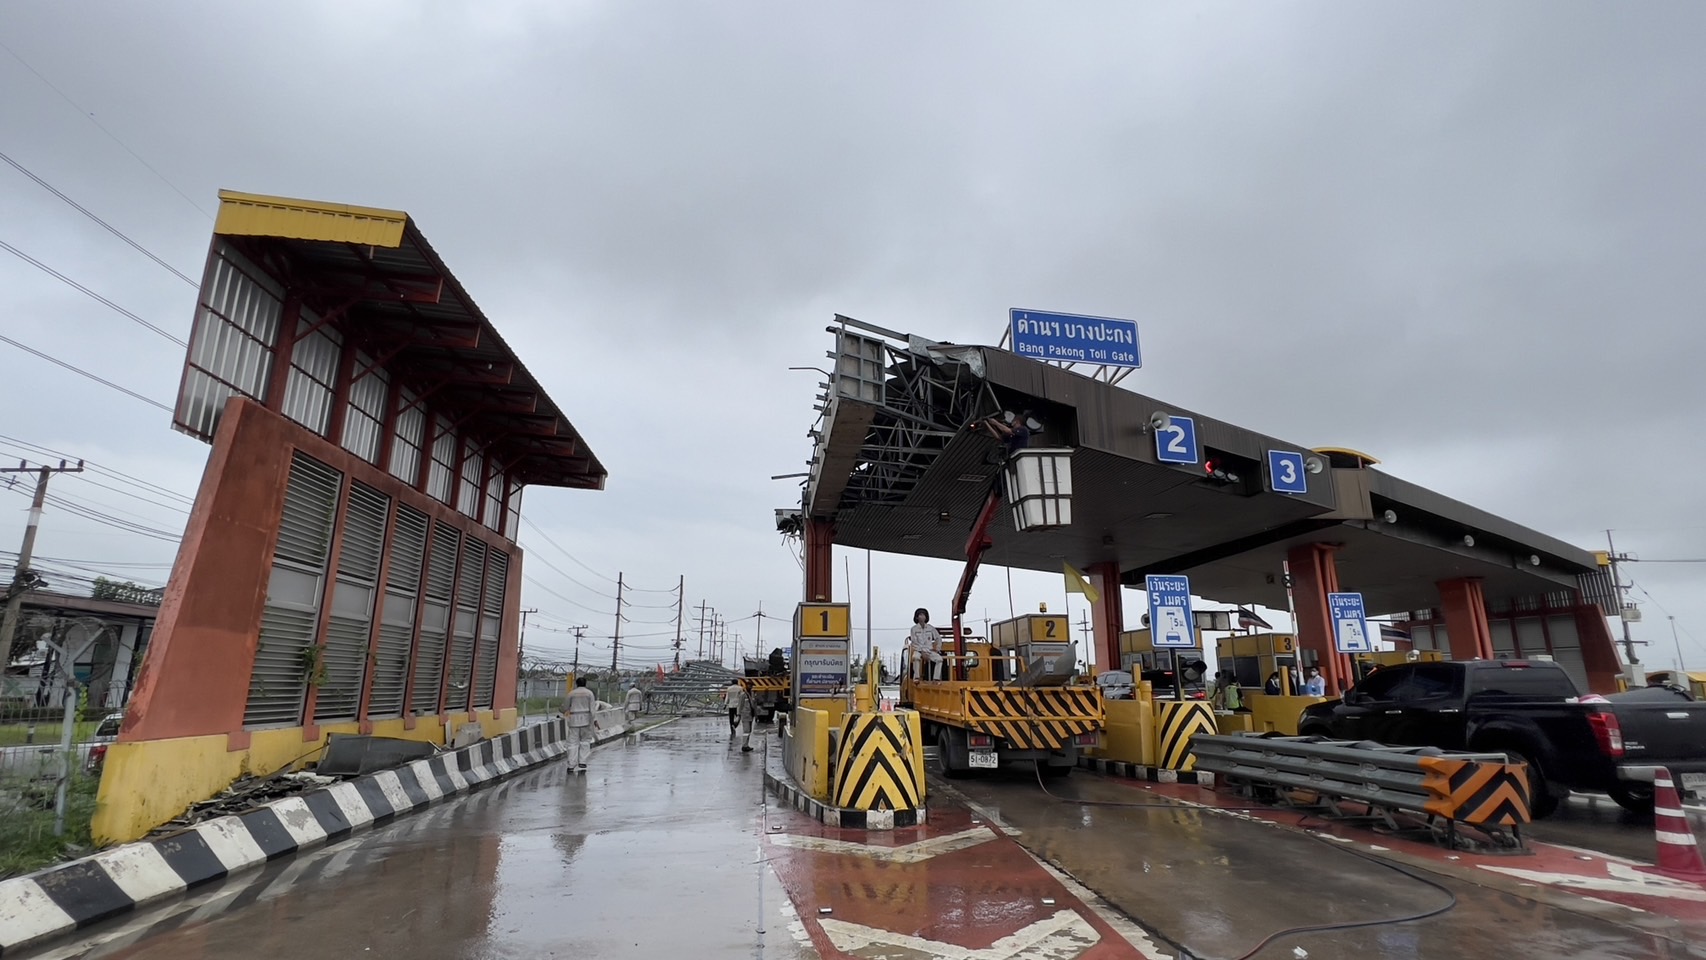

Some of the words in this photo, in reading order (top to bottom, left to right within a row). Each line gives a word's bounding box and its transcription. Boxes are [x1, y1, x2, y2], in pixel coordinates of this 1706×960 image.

[1017, 313, 1060, 338] ด่านฯ
[1064, 322, 1133, 345] บางปะกง
[1019, 342, 1045, 356] Bang
[1049, 345, 1085, 360] Pakong
[1089, 348, 1107, 360] Toll
[1111, 351, 1135, 362] Gate
[1167, 425, 1187, 454] 2
[1279, 459, 1297, 484] 3
[1149, 577, 1186, 591] เว้นระยะ
[1152, 592, 1161, 606] 5
[1164, 595, 1187, 606] เมตร
[1331, 595, 1360, 607] เว้นระยะ
[819, 610, 828, 632] 1
[1334, 608, 1341, 619] 5
[1344, 609, 1362, 619] เมตร
[1045, 620, 1056, 638] 2
[1284, 637, 1292, 651] 3
[804, 658, 844, 668] กรุณารับบัตร
